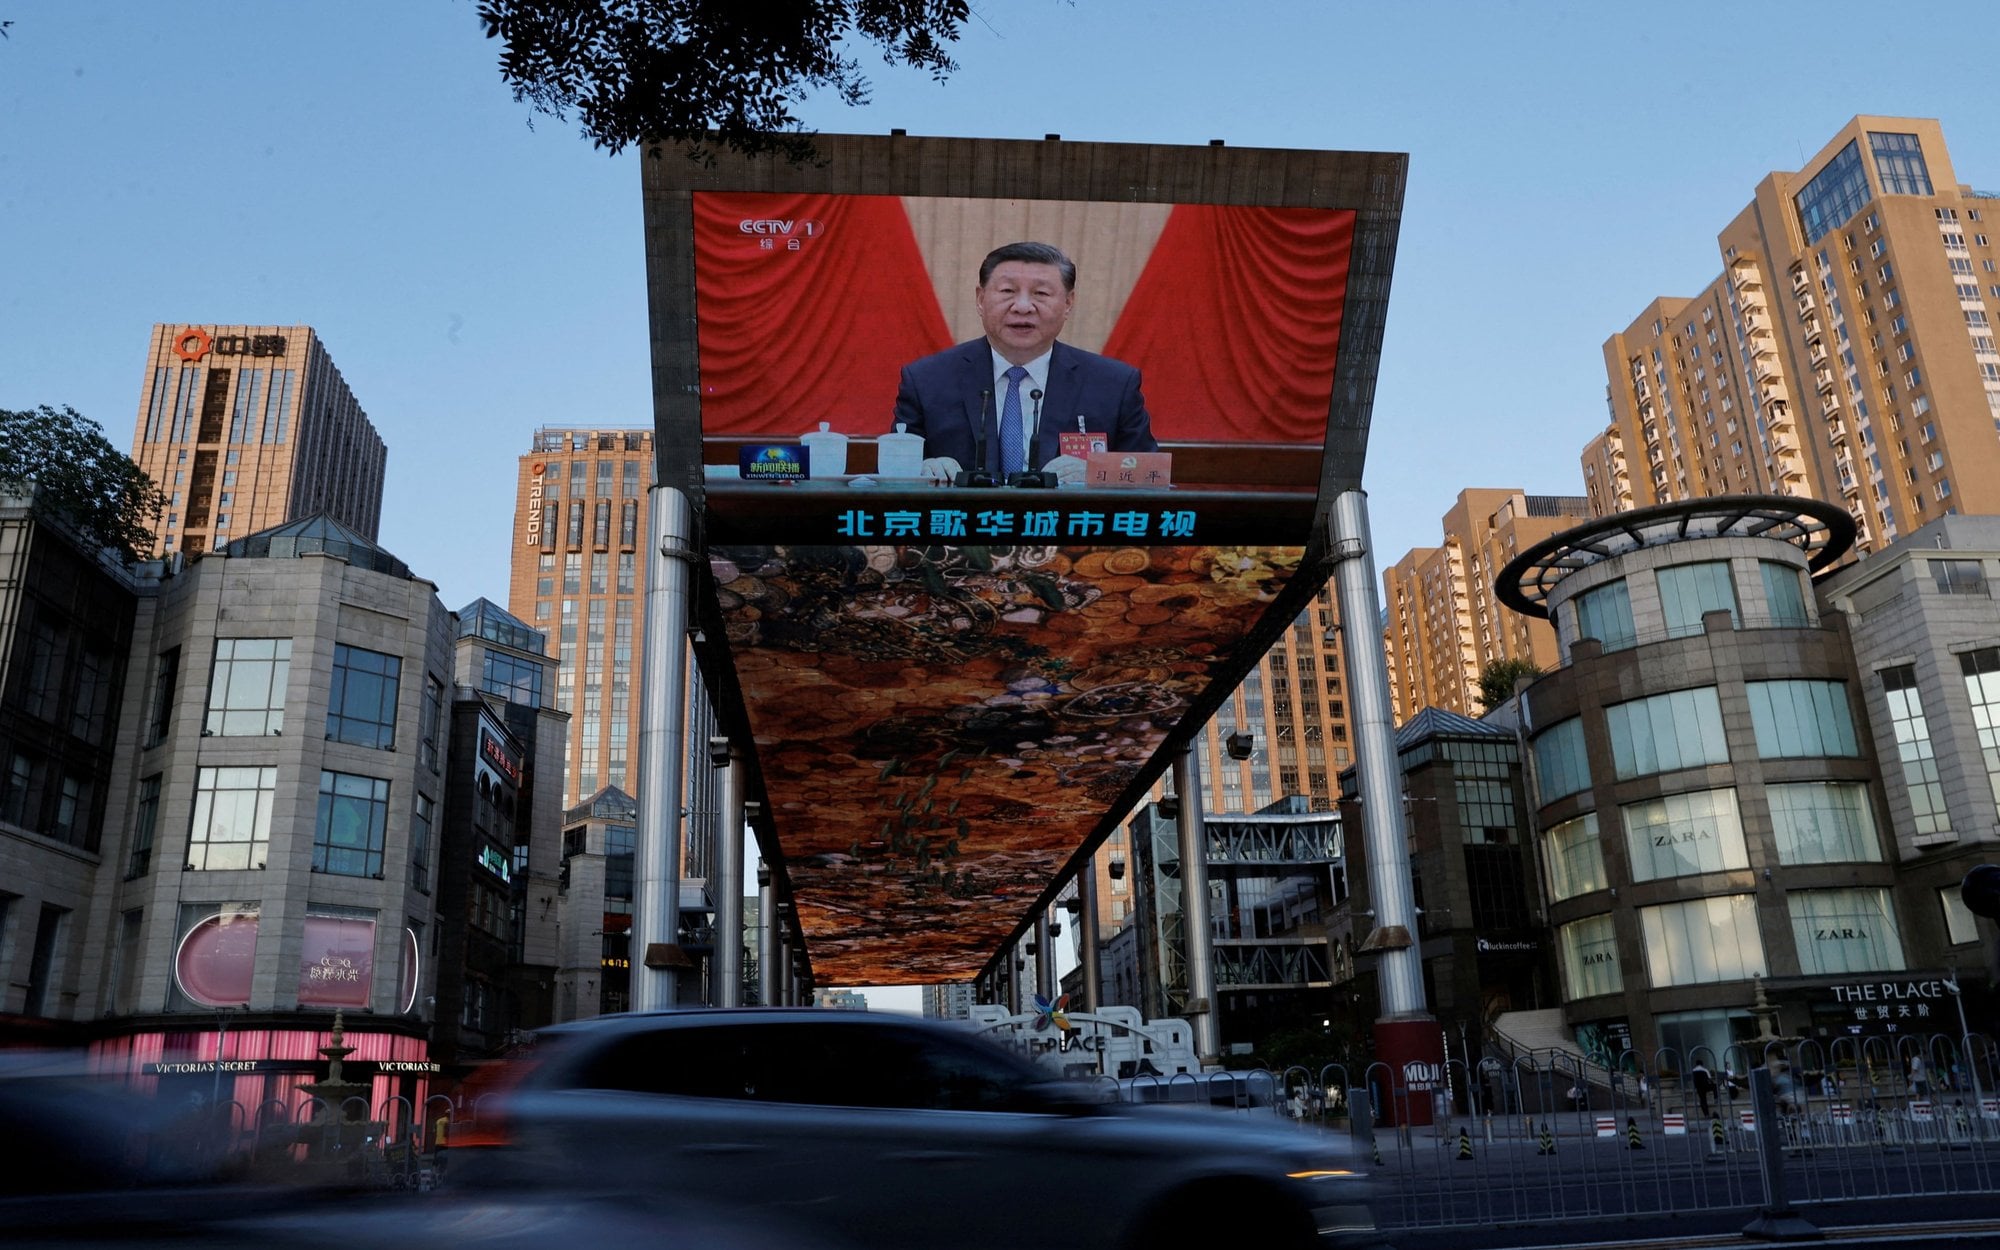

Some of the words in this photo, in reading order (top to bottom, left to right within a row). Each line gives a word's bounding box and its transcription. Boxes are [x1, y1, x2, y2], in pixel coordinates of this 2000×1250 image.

[739, 219, 794, 234] CCTV
[760, 238, 800, 251] 综合
[750, 461, 800, 473] 新闻联播
[1096, 470, 1160, 483] 习近平
[526, 474, 544, 546] TRENDS
[837, 509, 1197, 538] 北京歌华城市电视
[1654, 829, 1712, 848] ZARA
[1814, 928, 1868, 941] ZARA
[1582, 951, 1614, 966] ZARA
[1830, 984, 1877, 1002] THE
[1882, 981, 1943, 999] PLACE
[1854, 1003, 1930, 1020] 世贸天阶
[155, 1061, 215, 1074] VICTORIA'S
[219, 1060, 258, 1072] SECRET
[379, 1061, 430, 1072] VICTORIA'S
[1402, 1063, 1440, 1082] MUJI
